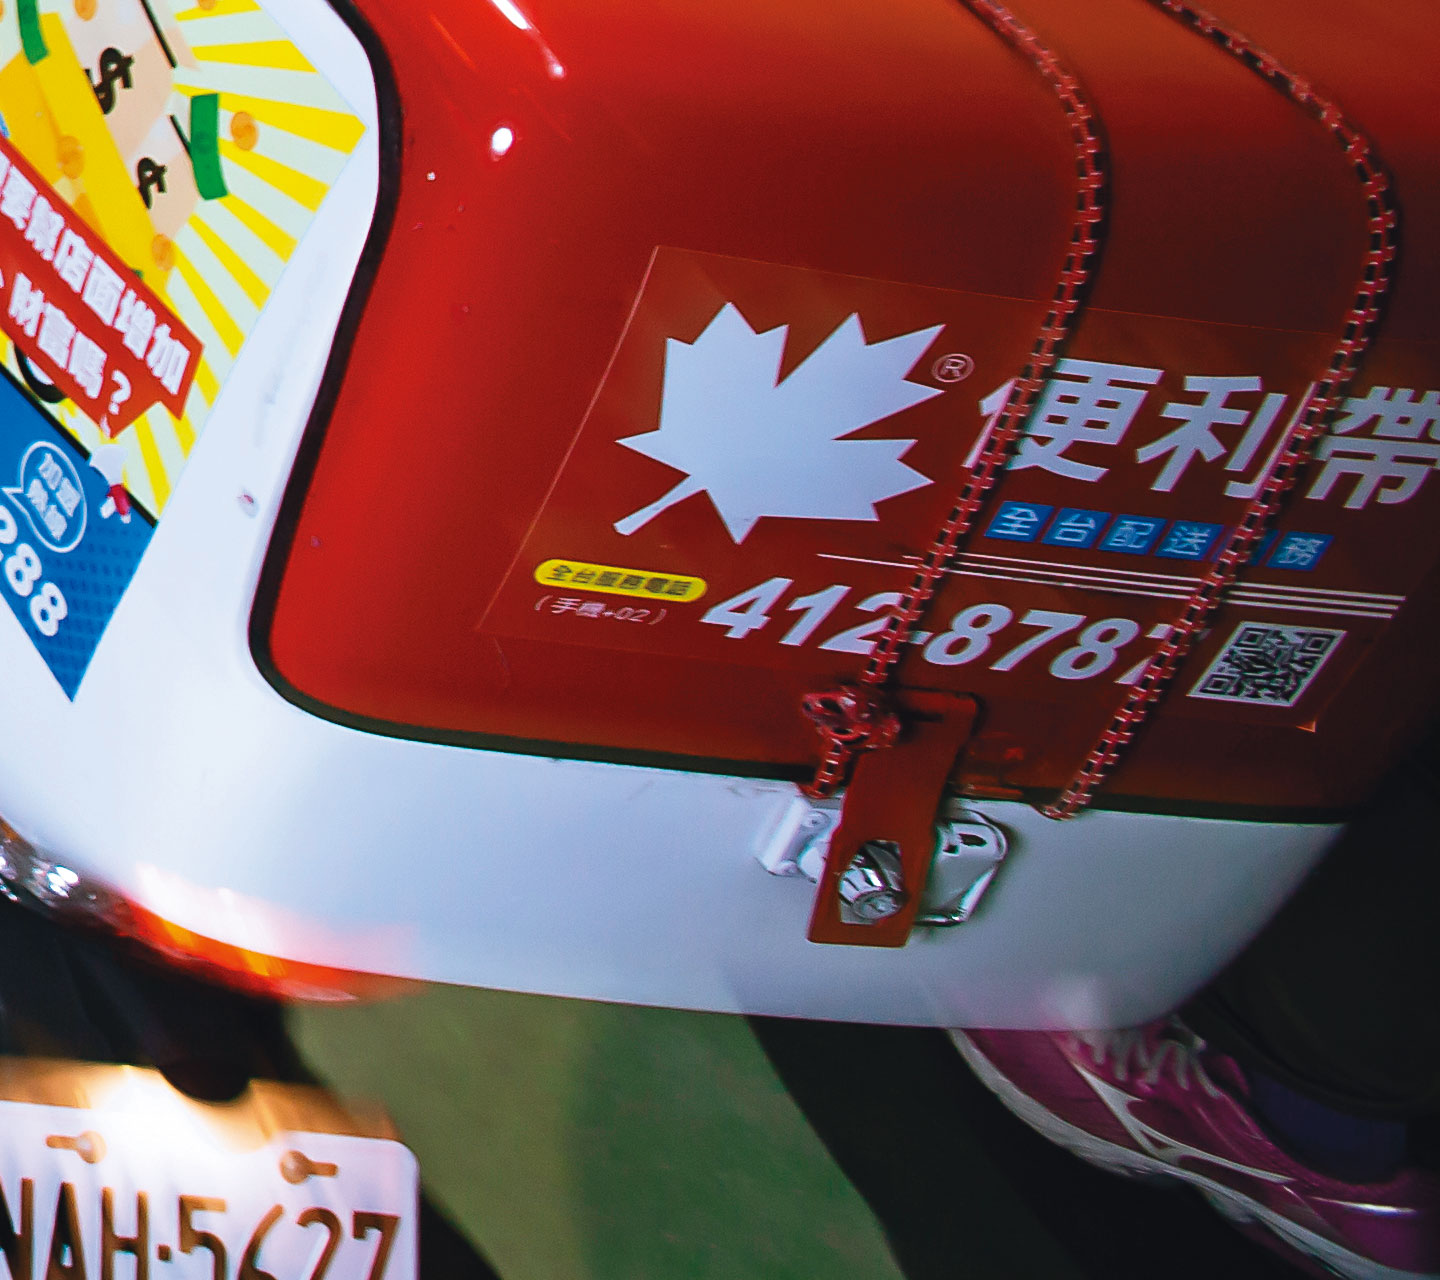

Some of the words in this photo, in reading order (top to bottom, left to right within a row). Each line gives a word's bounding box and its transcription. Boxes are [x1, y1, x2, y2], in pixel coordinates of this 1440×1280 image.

[962, 358, 1440, 510] 便利帶
[996, 505, 1328, 567] 全台配送務
